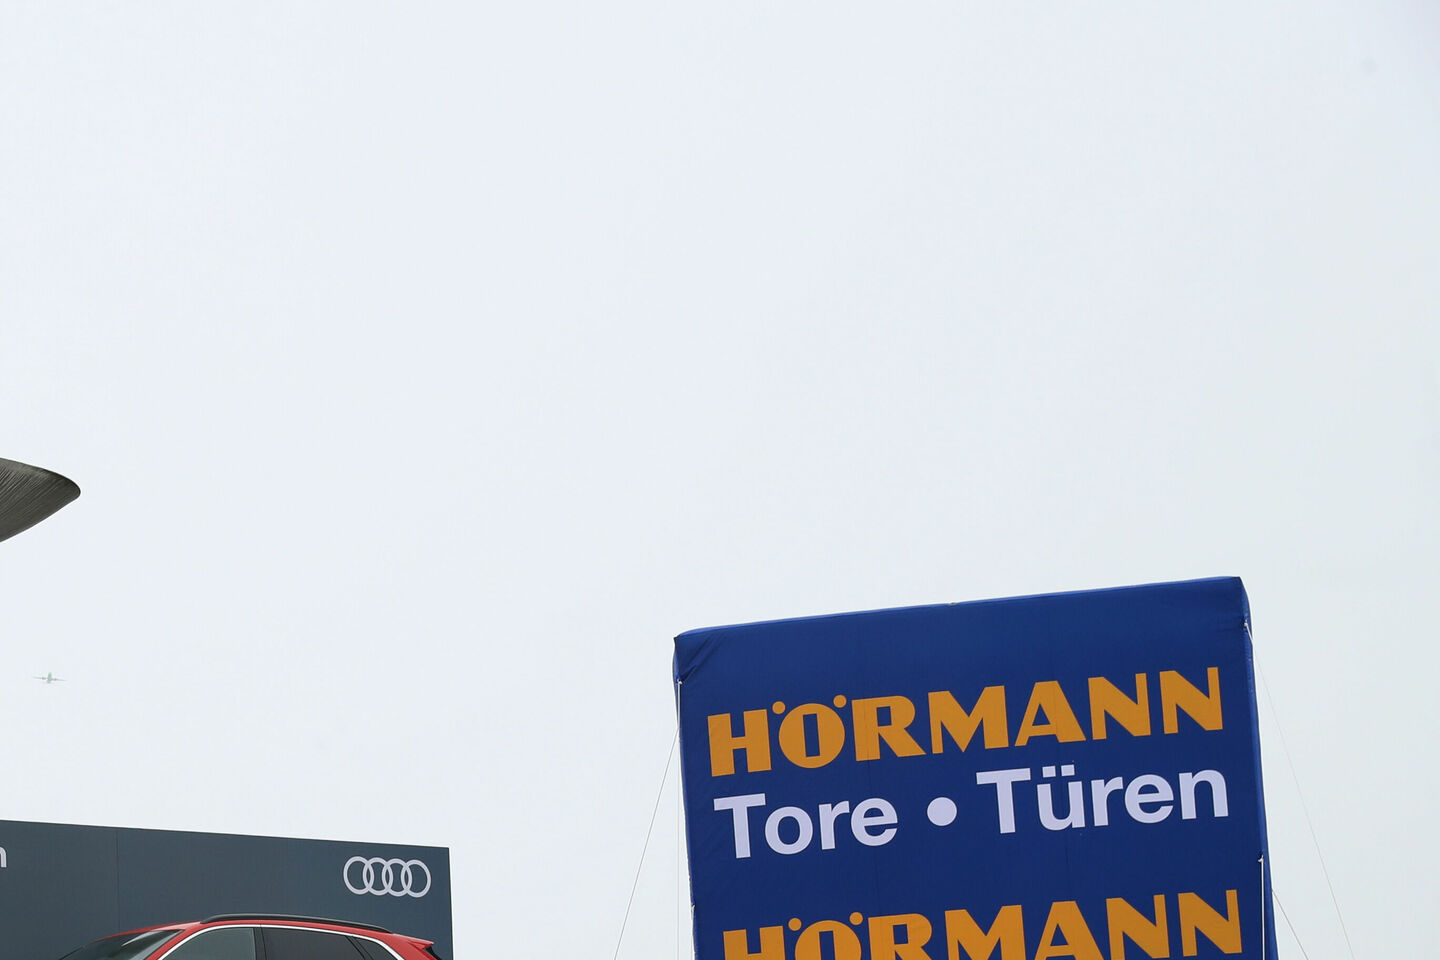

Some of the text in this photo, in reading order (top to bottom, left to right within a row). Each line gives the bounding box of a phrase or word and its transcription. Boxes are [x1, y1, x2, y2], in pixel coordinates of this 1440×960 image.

[707, 666, 1224, 777] HÖRMANN
[713, 763, 1230, 859] Tore Türen
